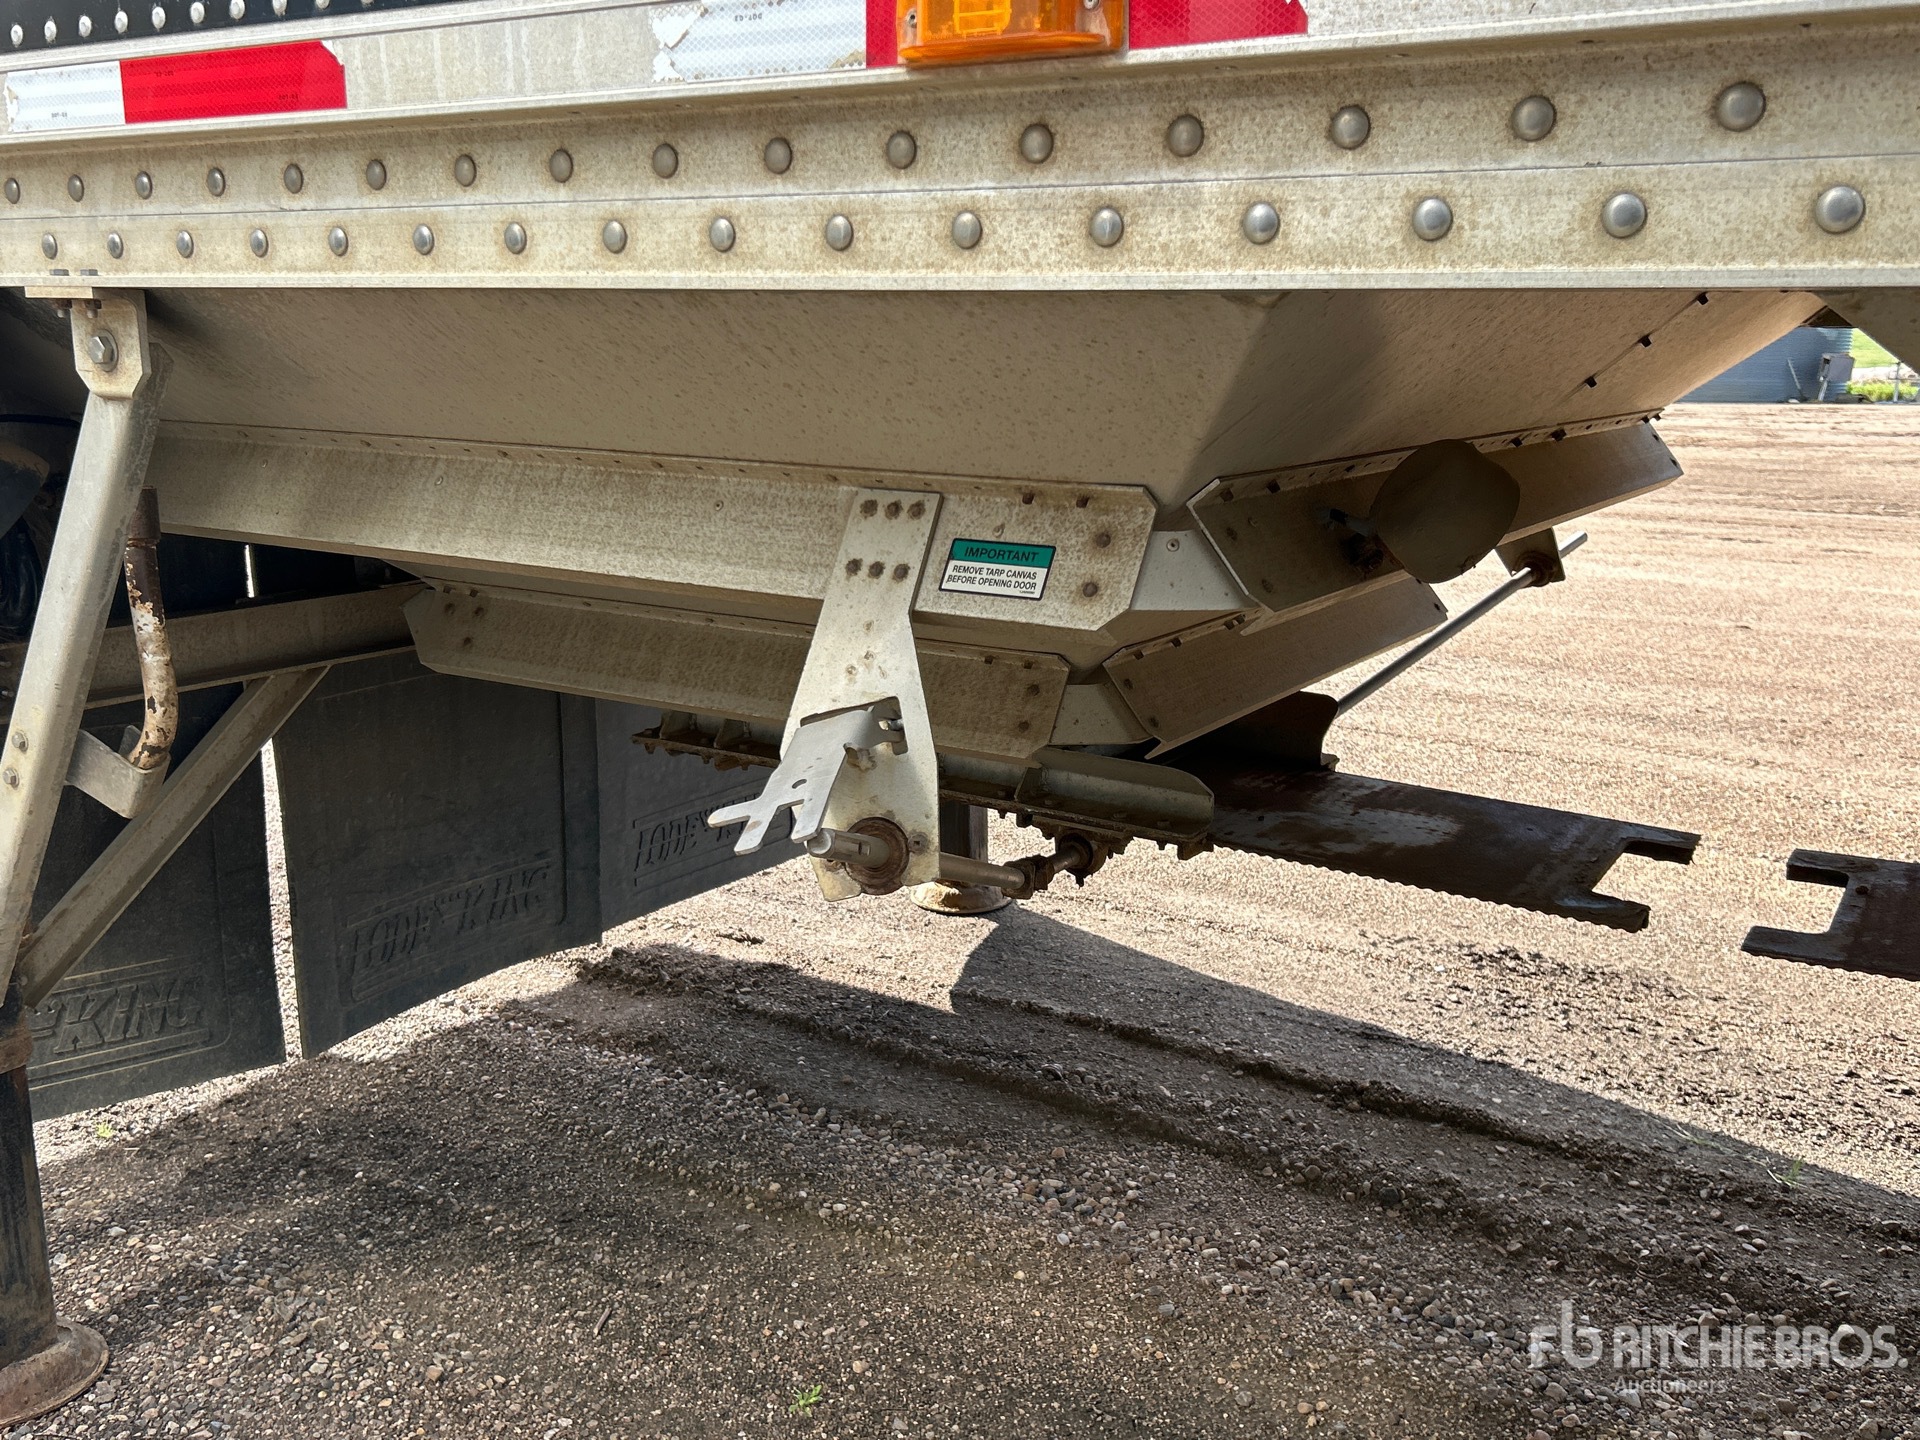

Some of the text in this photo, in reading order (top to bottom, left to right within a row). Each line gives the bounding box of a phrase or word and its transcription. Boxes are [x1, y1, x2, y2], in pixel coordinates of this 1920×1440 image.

[964, 546, 1039, 562] IMPORTANT
[952, 564, 1037, 580] REMOVE TARP CANVAS
[947, 574, 1037, 590] BEFORE OPENING DOOR
